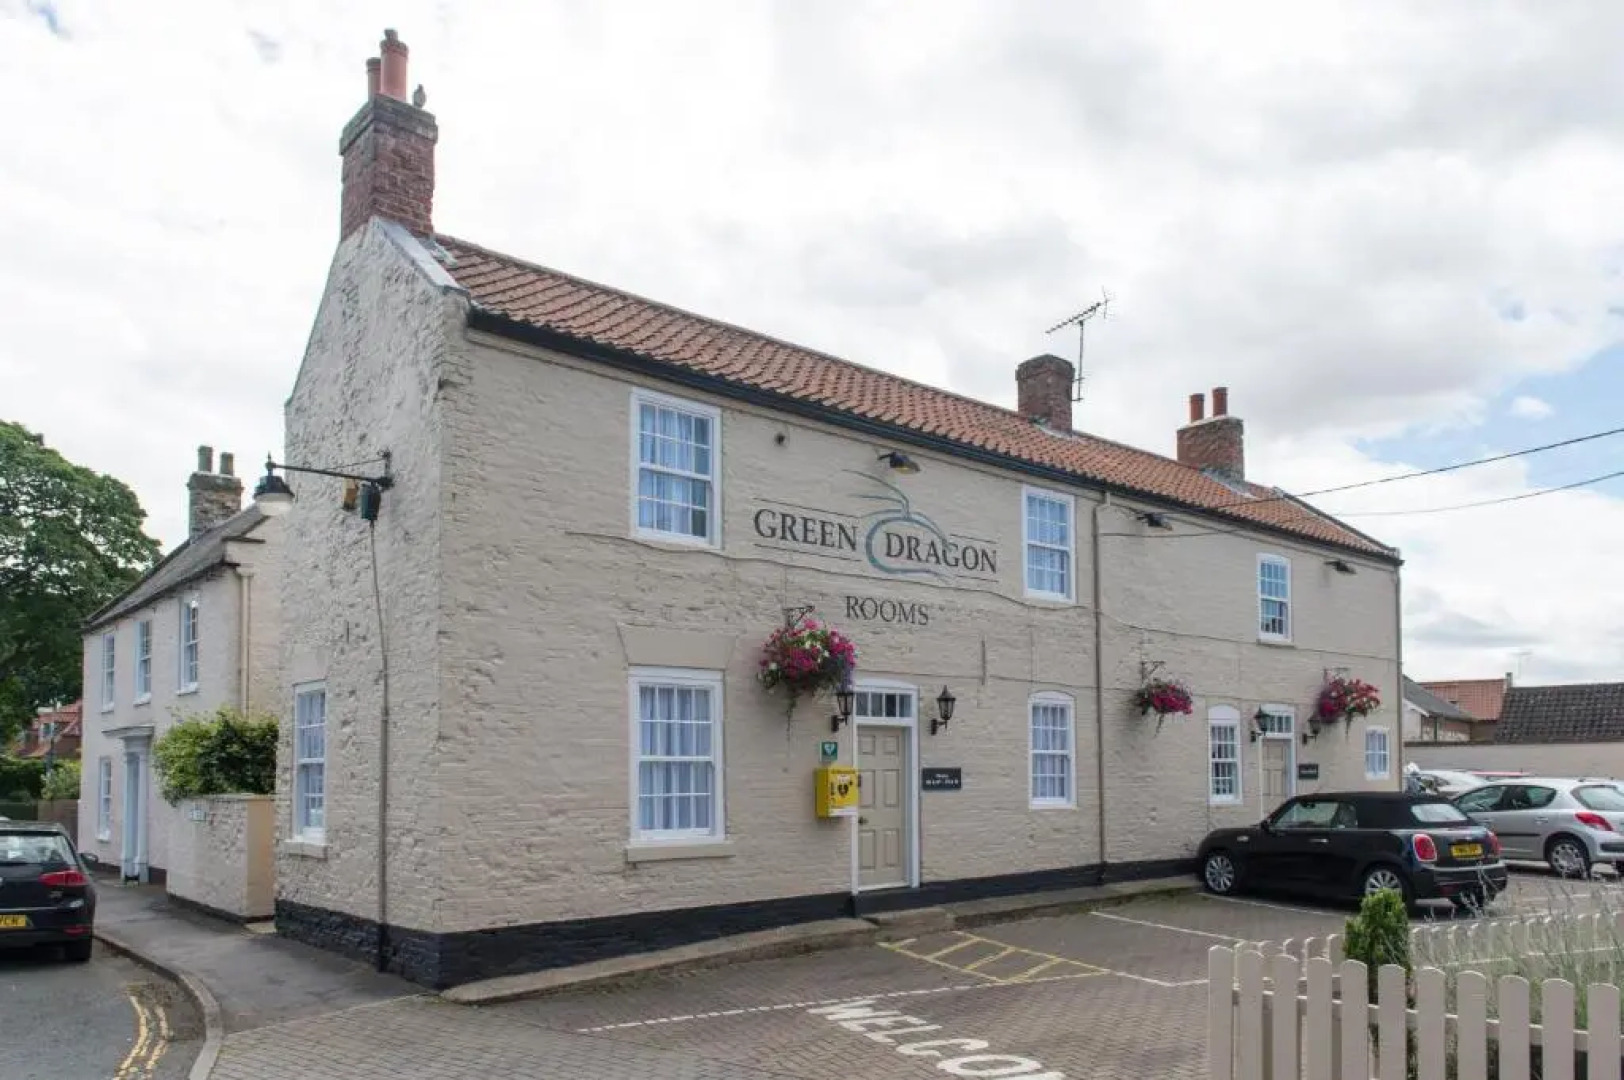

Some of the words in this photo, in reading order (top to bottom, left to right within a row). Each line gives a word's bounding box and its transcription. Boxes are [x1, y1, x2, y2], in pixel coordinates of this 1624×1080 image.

[753, 508, 858, 551] GREEN
[885, 532, 998, 574] DRAGON
[845, 595, 930, 626] ROOMS
[806, 1000, 1067, 1080] WELCO
